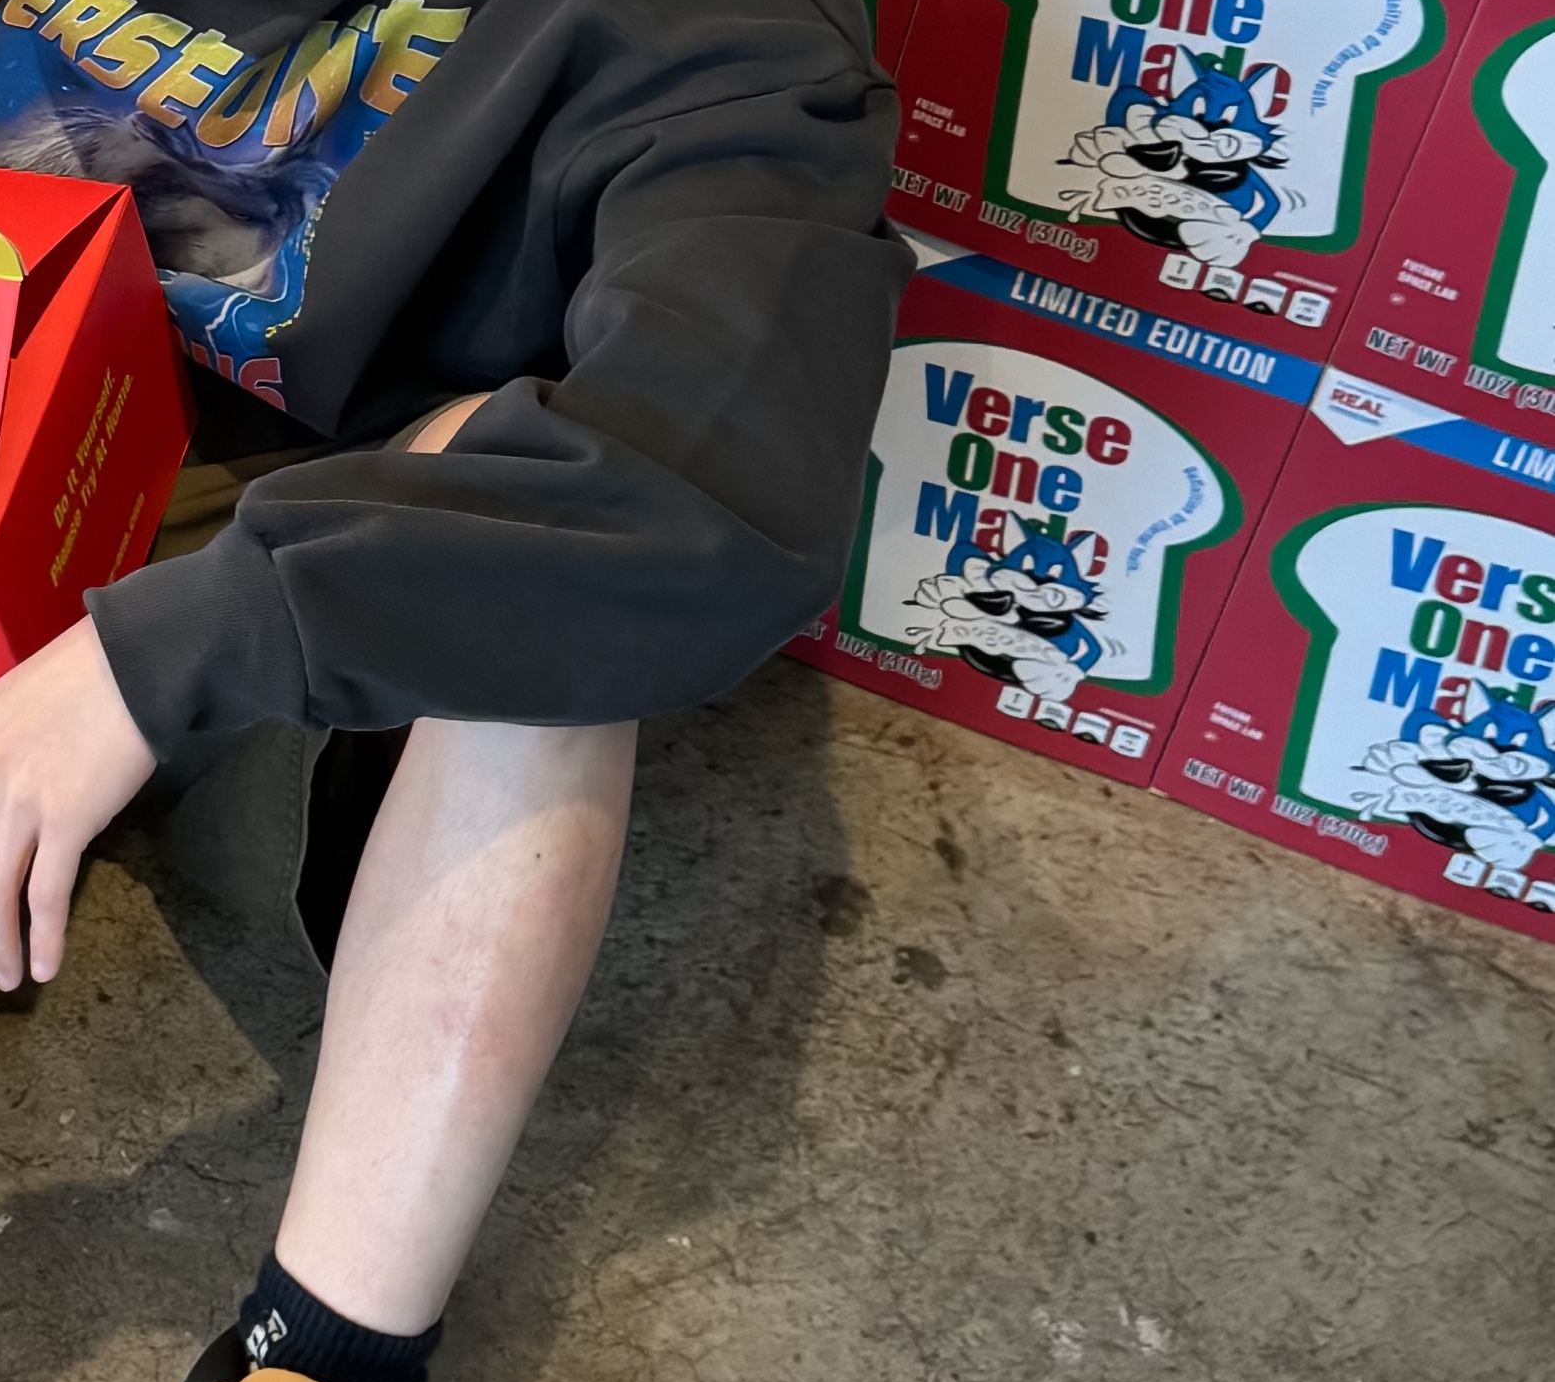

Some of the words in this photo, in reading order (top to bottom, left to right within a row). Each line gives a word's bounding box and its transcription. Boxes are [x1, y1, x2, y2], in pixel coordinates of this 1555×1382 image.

[1009, 269, 1142, 339] LIMITED
[1146, 317, 1275, 385] EDITION
[926, 361, 1133, 465] Verse
[947, 432, 1081, 511] One
[1409, 597, 1555, 681] One
